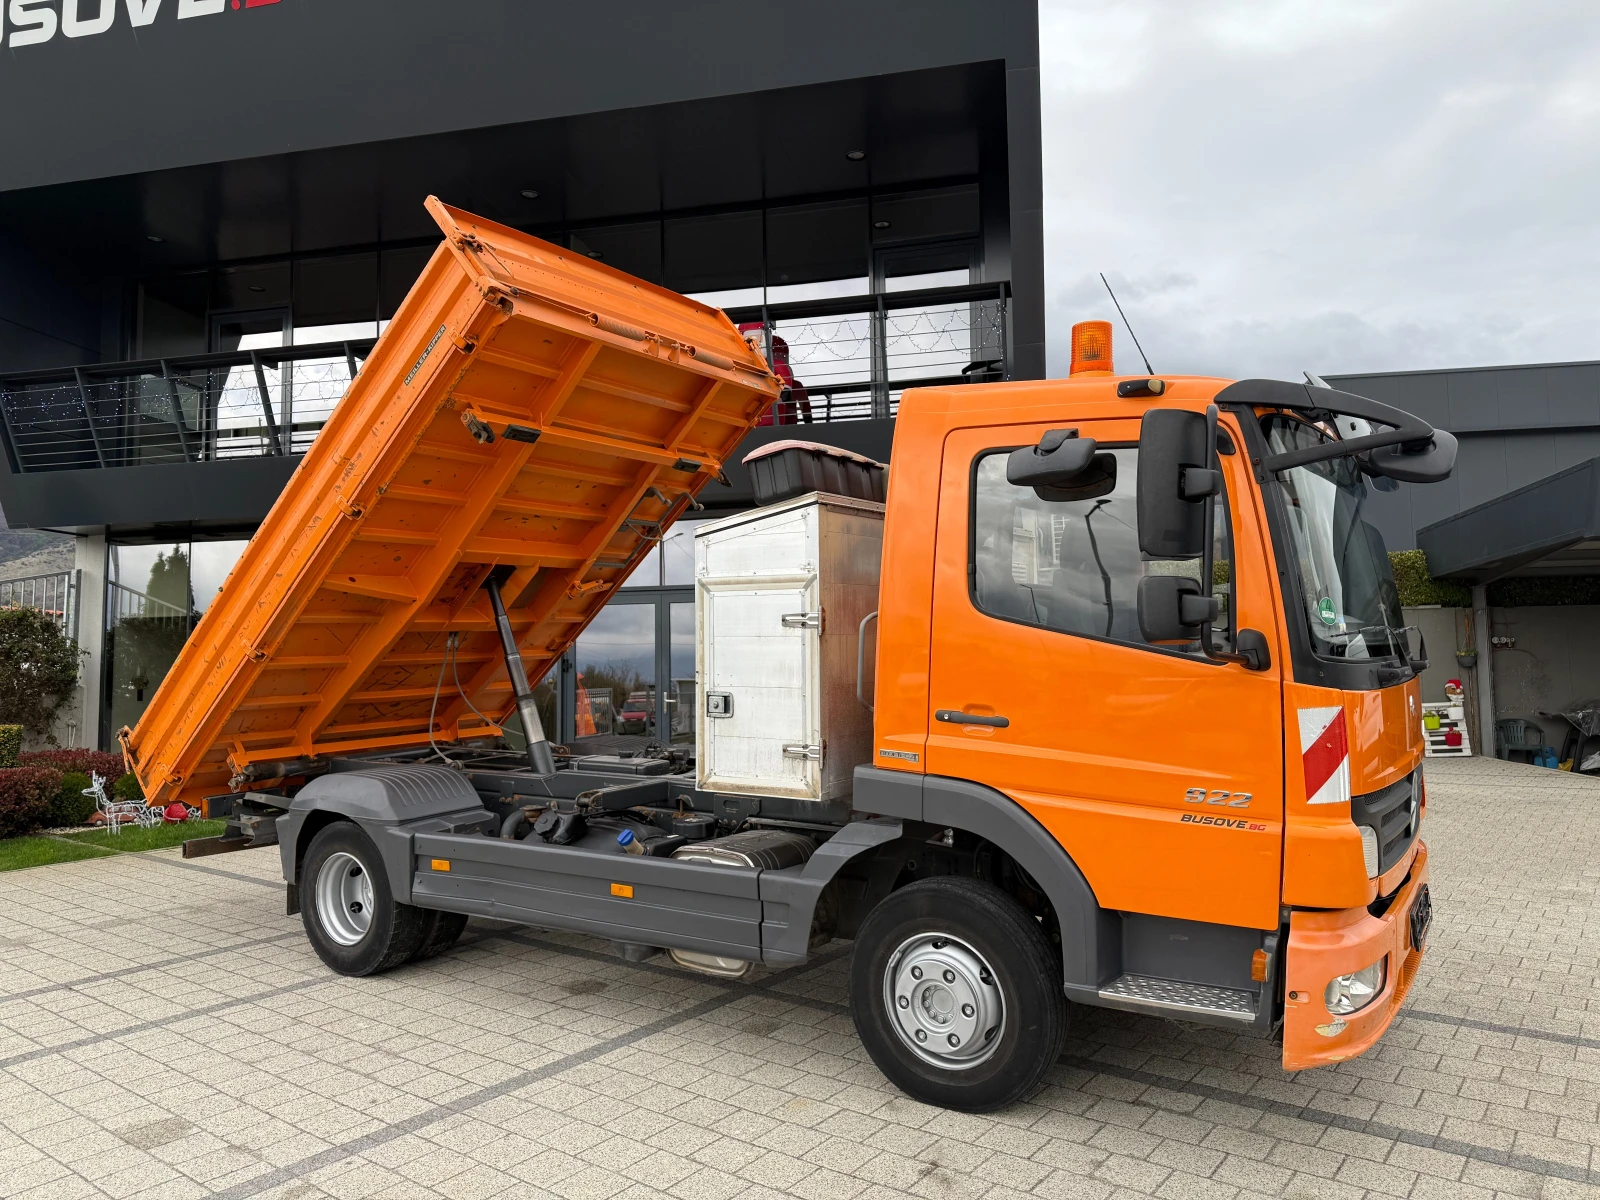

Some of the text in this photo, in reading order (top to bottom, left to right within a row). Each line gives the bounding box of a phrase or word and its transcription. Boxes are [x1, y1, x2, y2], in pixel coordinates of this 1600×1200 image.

[404, 325, 446, 385] MEILLER-KIPPER
[1184, 787, 1252, 808] 922
[1180, 814, 1266, 831] BUSOVE.BG
